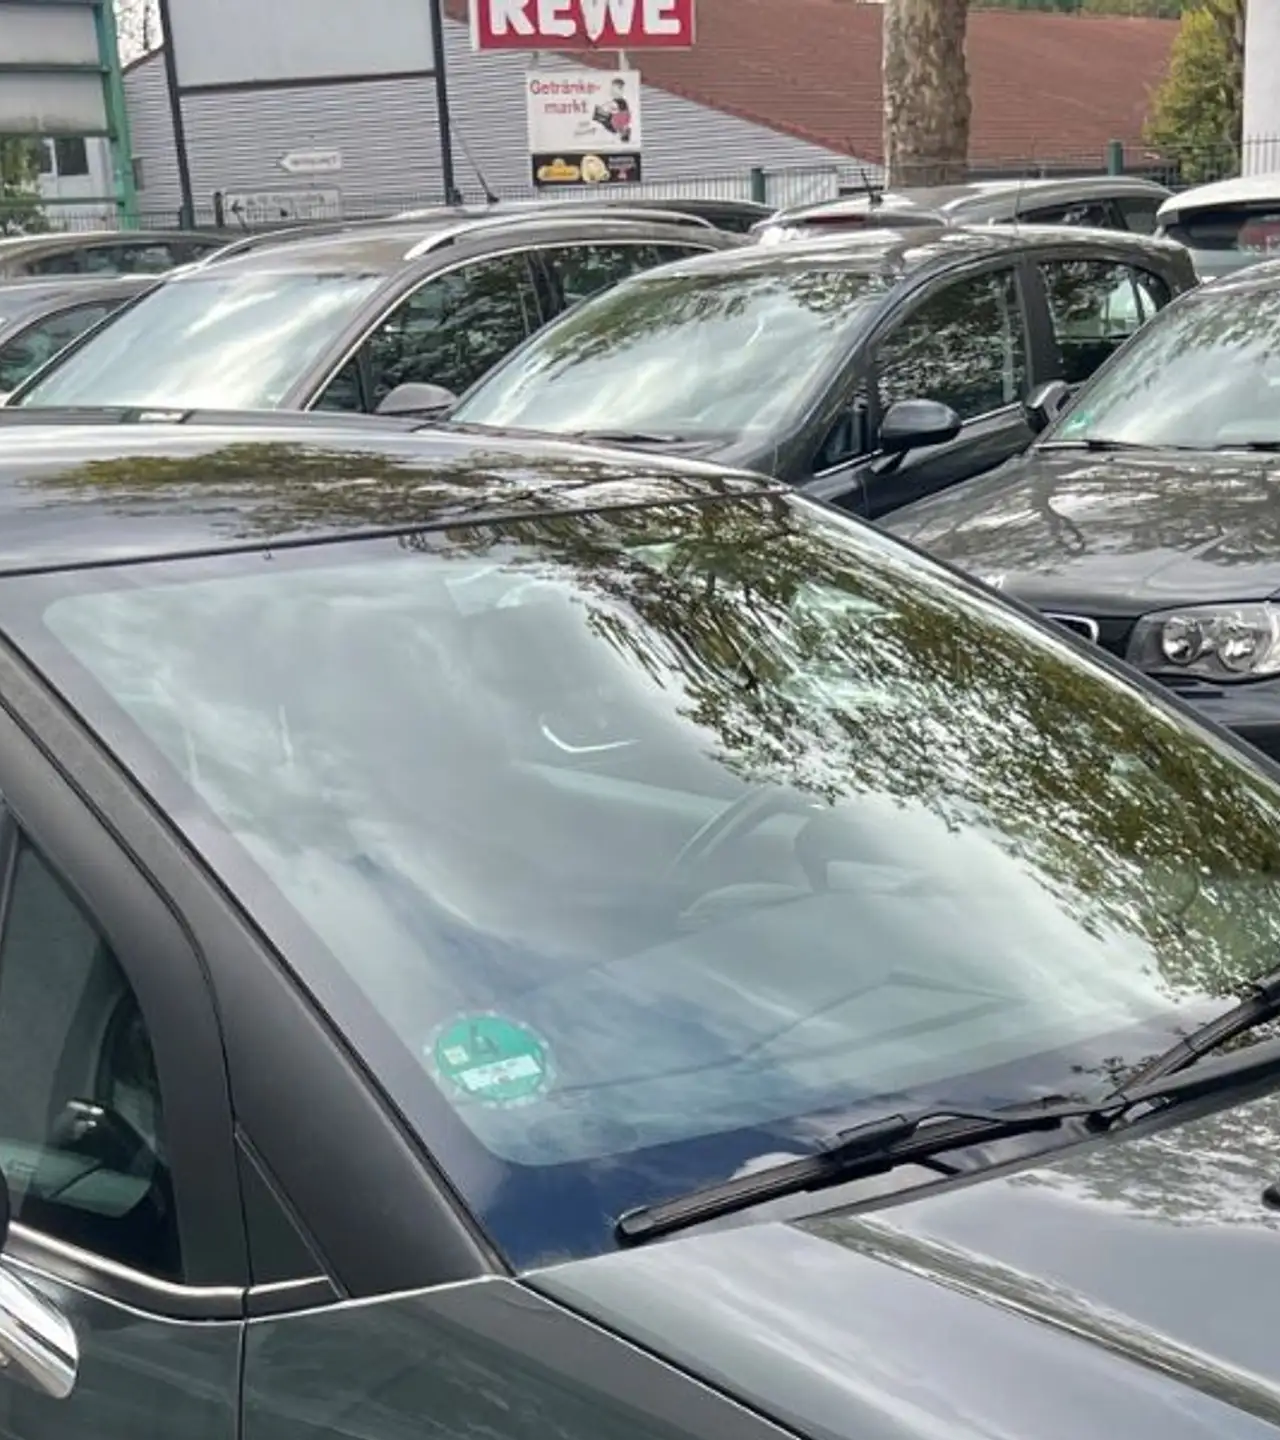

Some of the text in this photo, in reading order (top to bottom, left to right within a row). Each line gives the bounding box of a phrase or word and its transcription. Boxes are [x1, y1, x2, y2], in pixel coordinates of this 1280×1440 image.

[489, 0, 682, 41] REWE
[530, 79, 601, 95] Getränke-
[544, 99, 588, 114] markt
